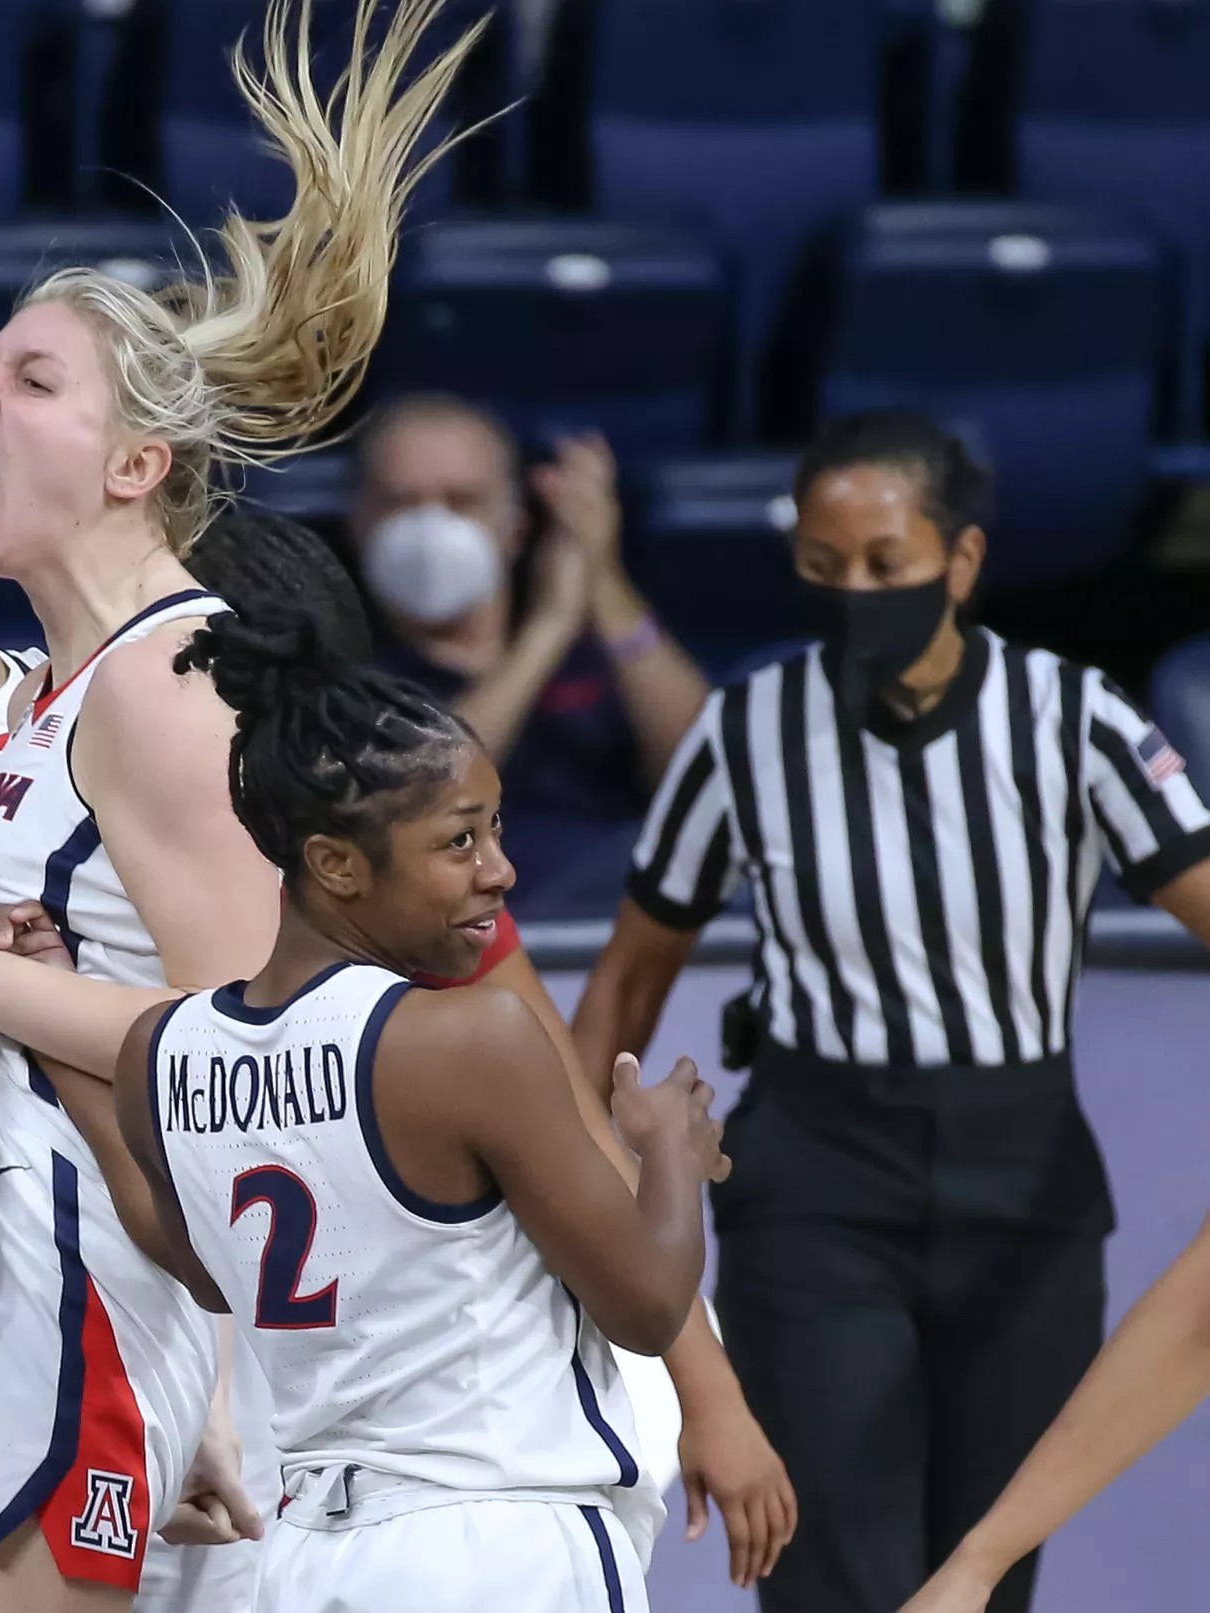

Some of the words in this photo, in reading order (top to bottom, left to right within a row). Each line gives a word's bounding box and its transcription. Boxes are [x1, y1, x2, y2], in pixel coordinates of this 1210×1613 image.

[166, 1043, 347, 1133] McDONALD
[229, 1164, 339, 1330] 2
[71, 1469, 138, 1560] A
